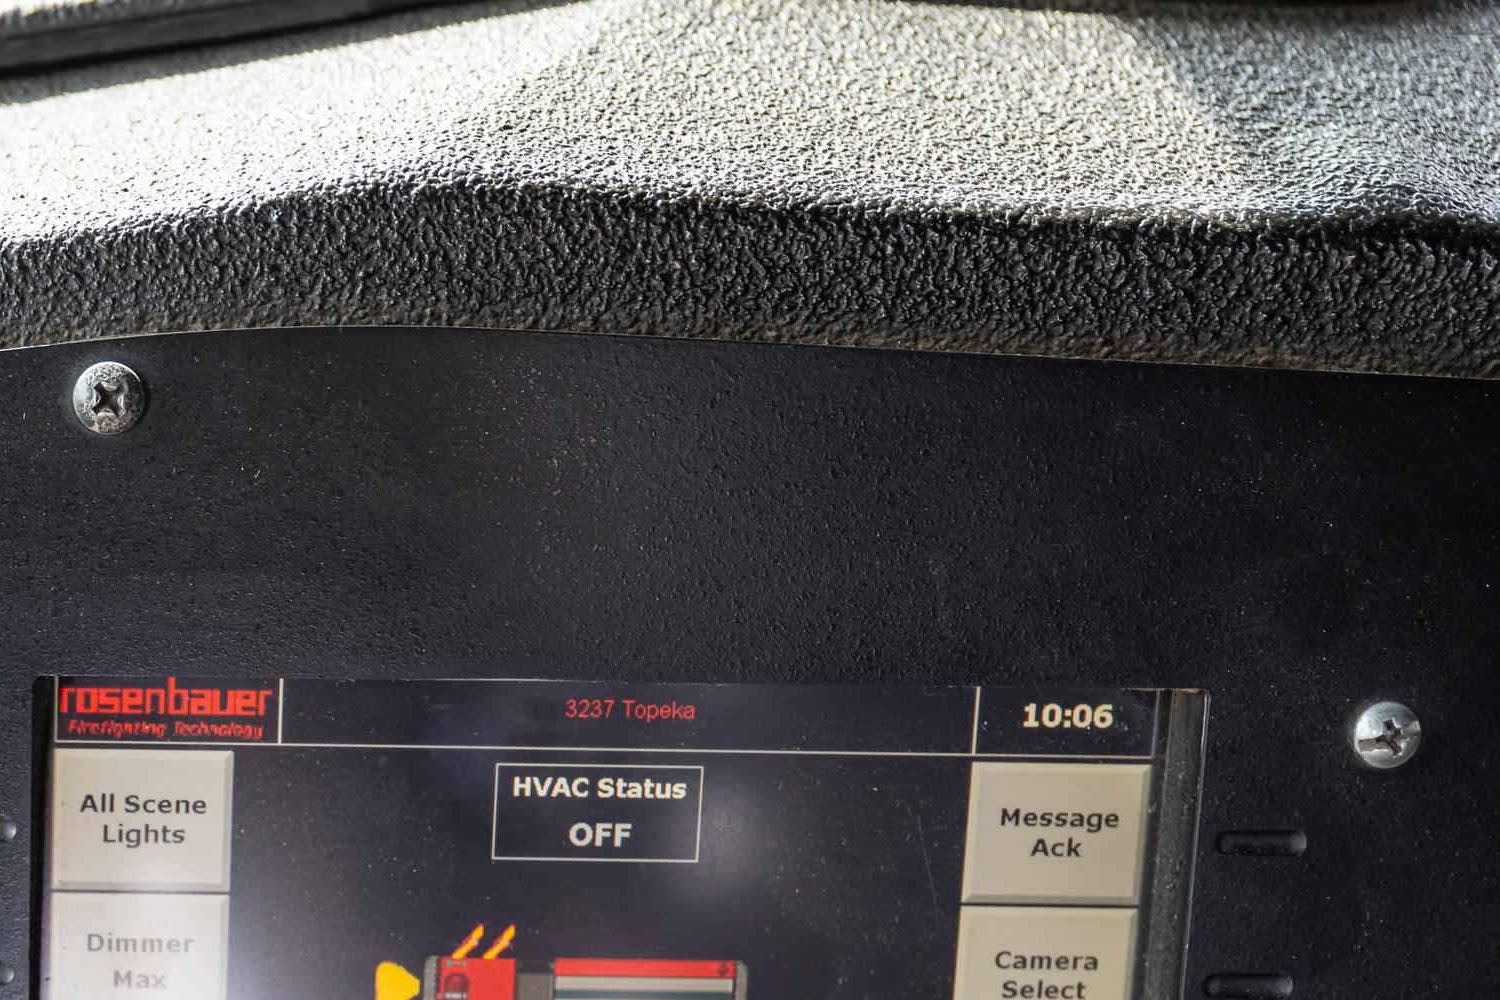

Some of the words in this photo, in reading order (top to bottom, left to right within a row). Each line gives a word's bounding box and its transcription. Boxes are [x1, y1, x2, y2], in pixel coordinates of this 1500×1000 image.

[59, 676, 272, 716] rosenbauer
[565, 700, 615, 719] 3237
[624, 701, 696, 721] Topeka
[1023, 703, 1113, 728] 10:06
[174, 721, 264, 740] Technology
[513, 777, 590, 797] HVAC
[598, 778, 687, 799] Status
[80, 794, 116, 814] All
[123, 794, 208, 815] Scene
[1000, 807, 1120, 832] Message
[102, 823, 186, 849] Lights
[569, 823, 632, 848] OFF
[1030, 837, 1082, 858] Ack
[86, 932, 194, 954] Dimmer
[995, 950, 1099, 972] Camera
[113, 969, 168, 989] Max
[1001, 979, 1087, 1000] Select
